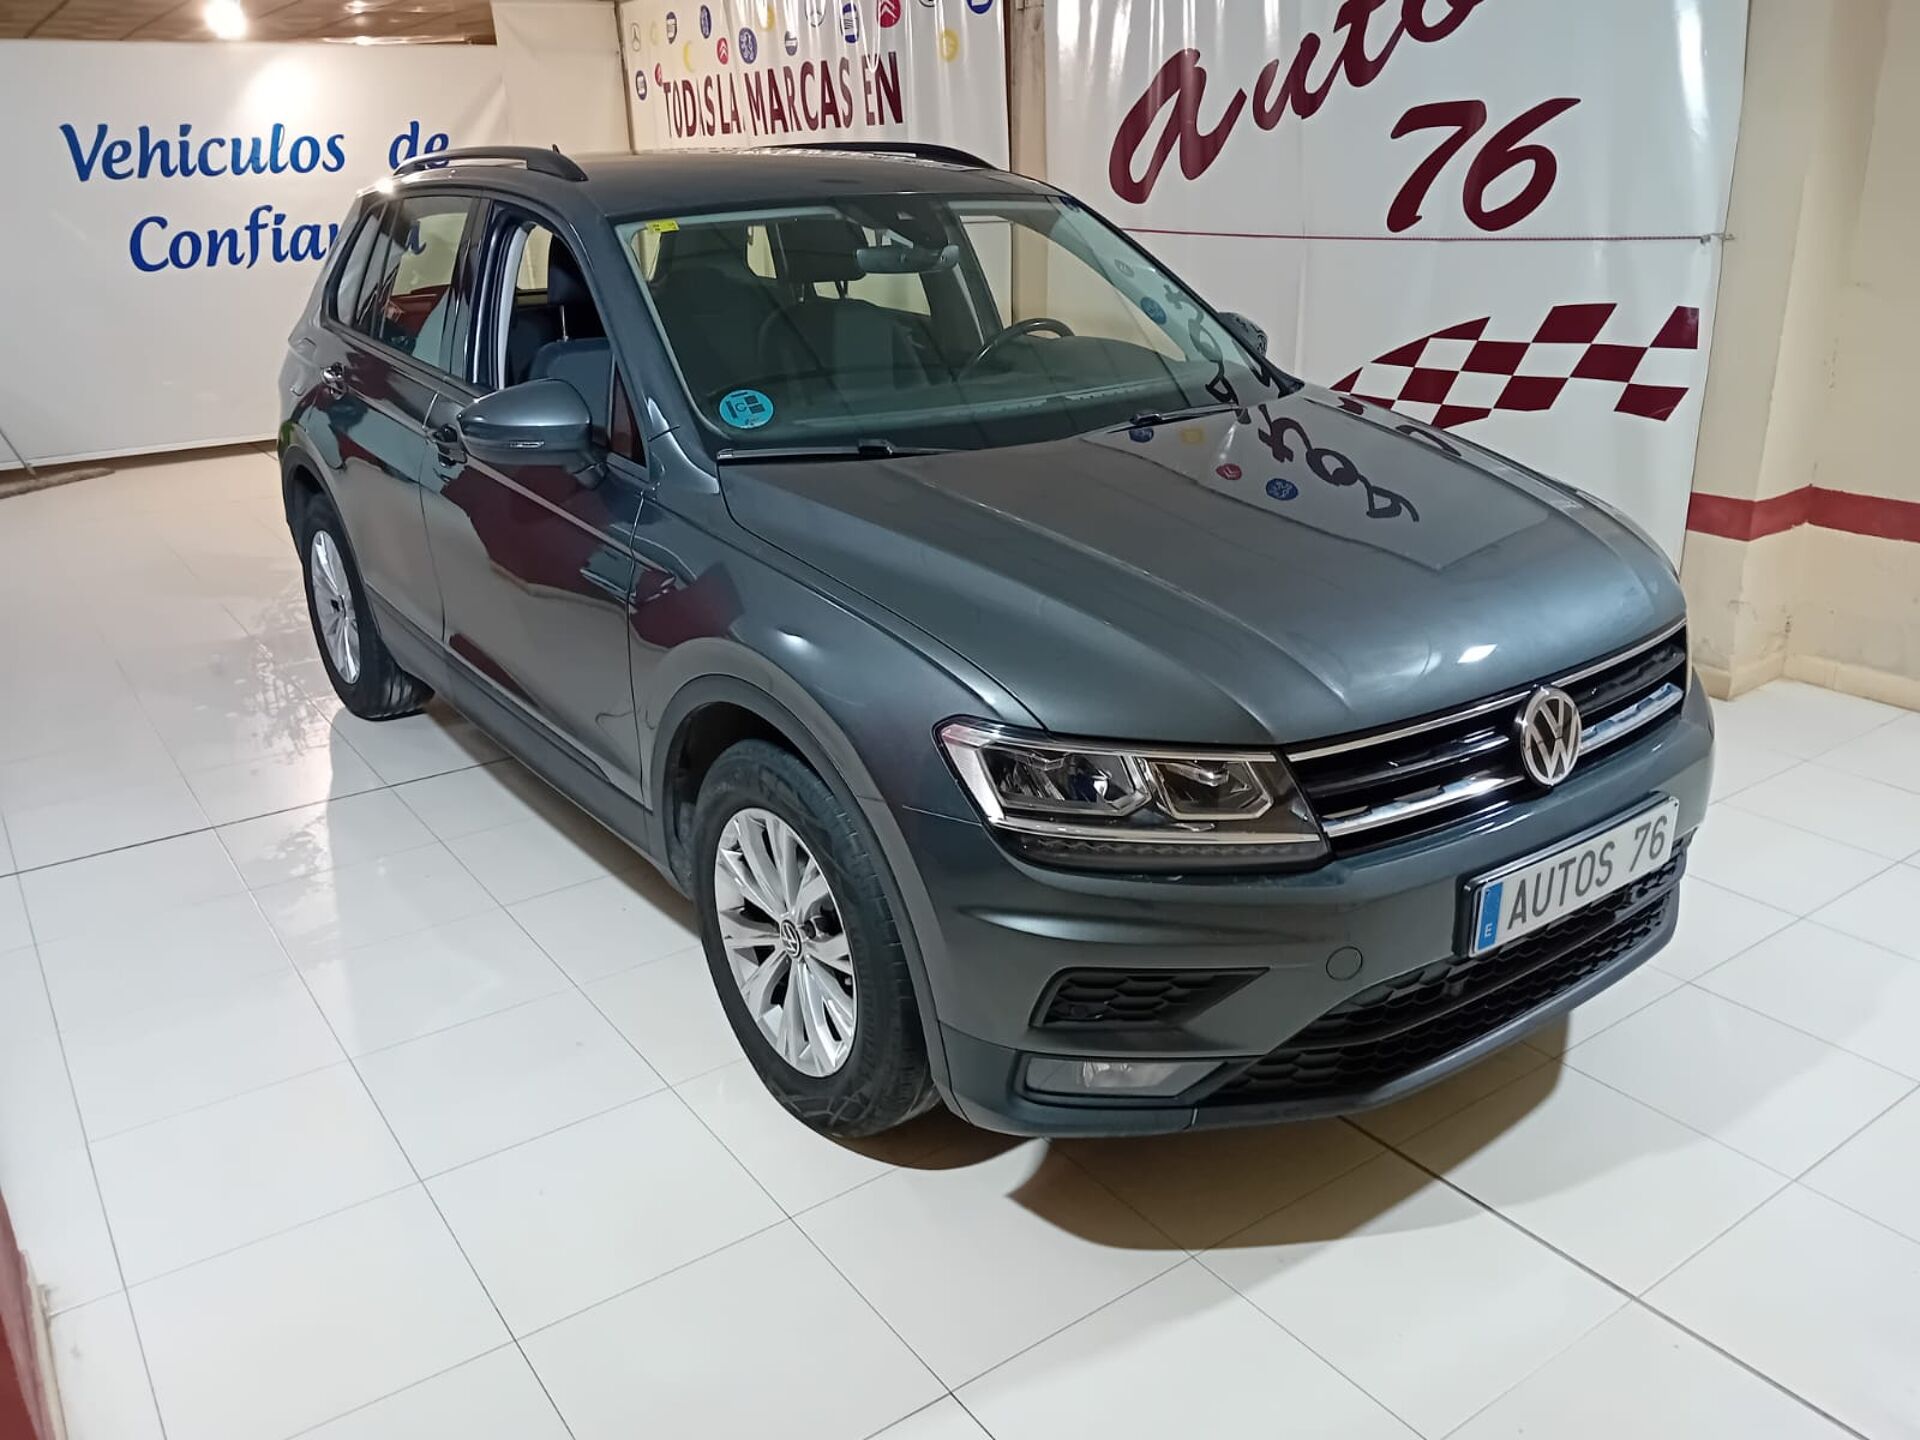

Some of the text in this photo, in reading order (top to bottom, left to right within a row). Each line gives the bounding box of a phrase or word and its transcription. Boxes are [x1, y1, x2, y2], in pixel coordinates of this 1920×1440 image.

[744, 56, 854, 136] MARCAS
[861, 51, 903, 126] EN
[388, 120, 450, 170] de
[1386, 98, 1581, 232] 76
[1507, 841, 1615, 930] AUTOS
[1629, 815, 1668, 872] 76
